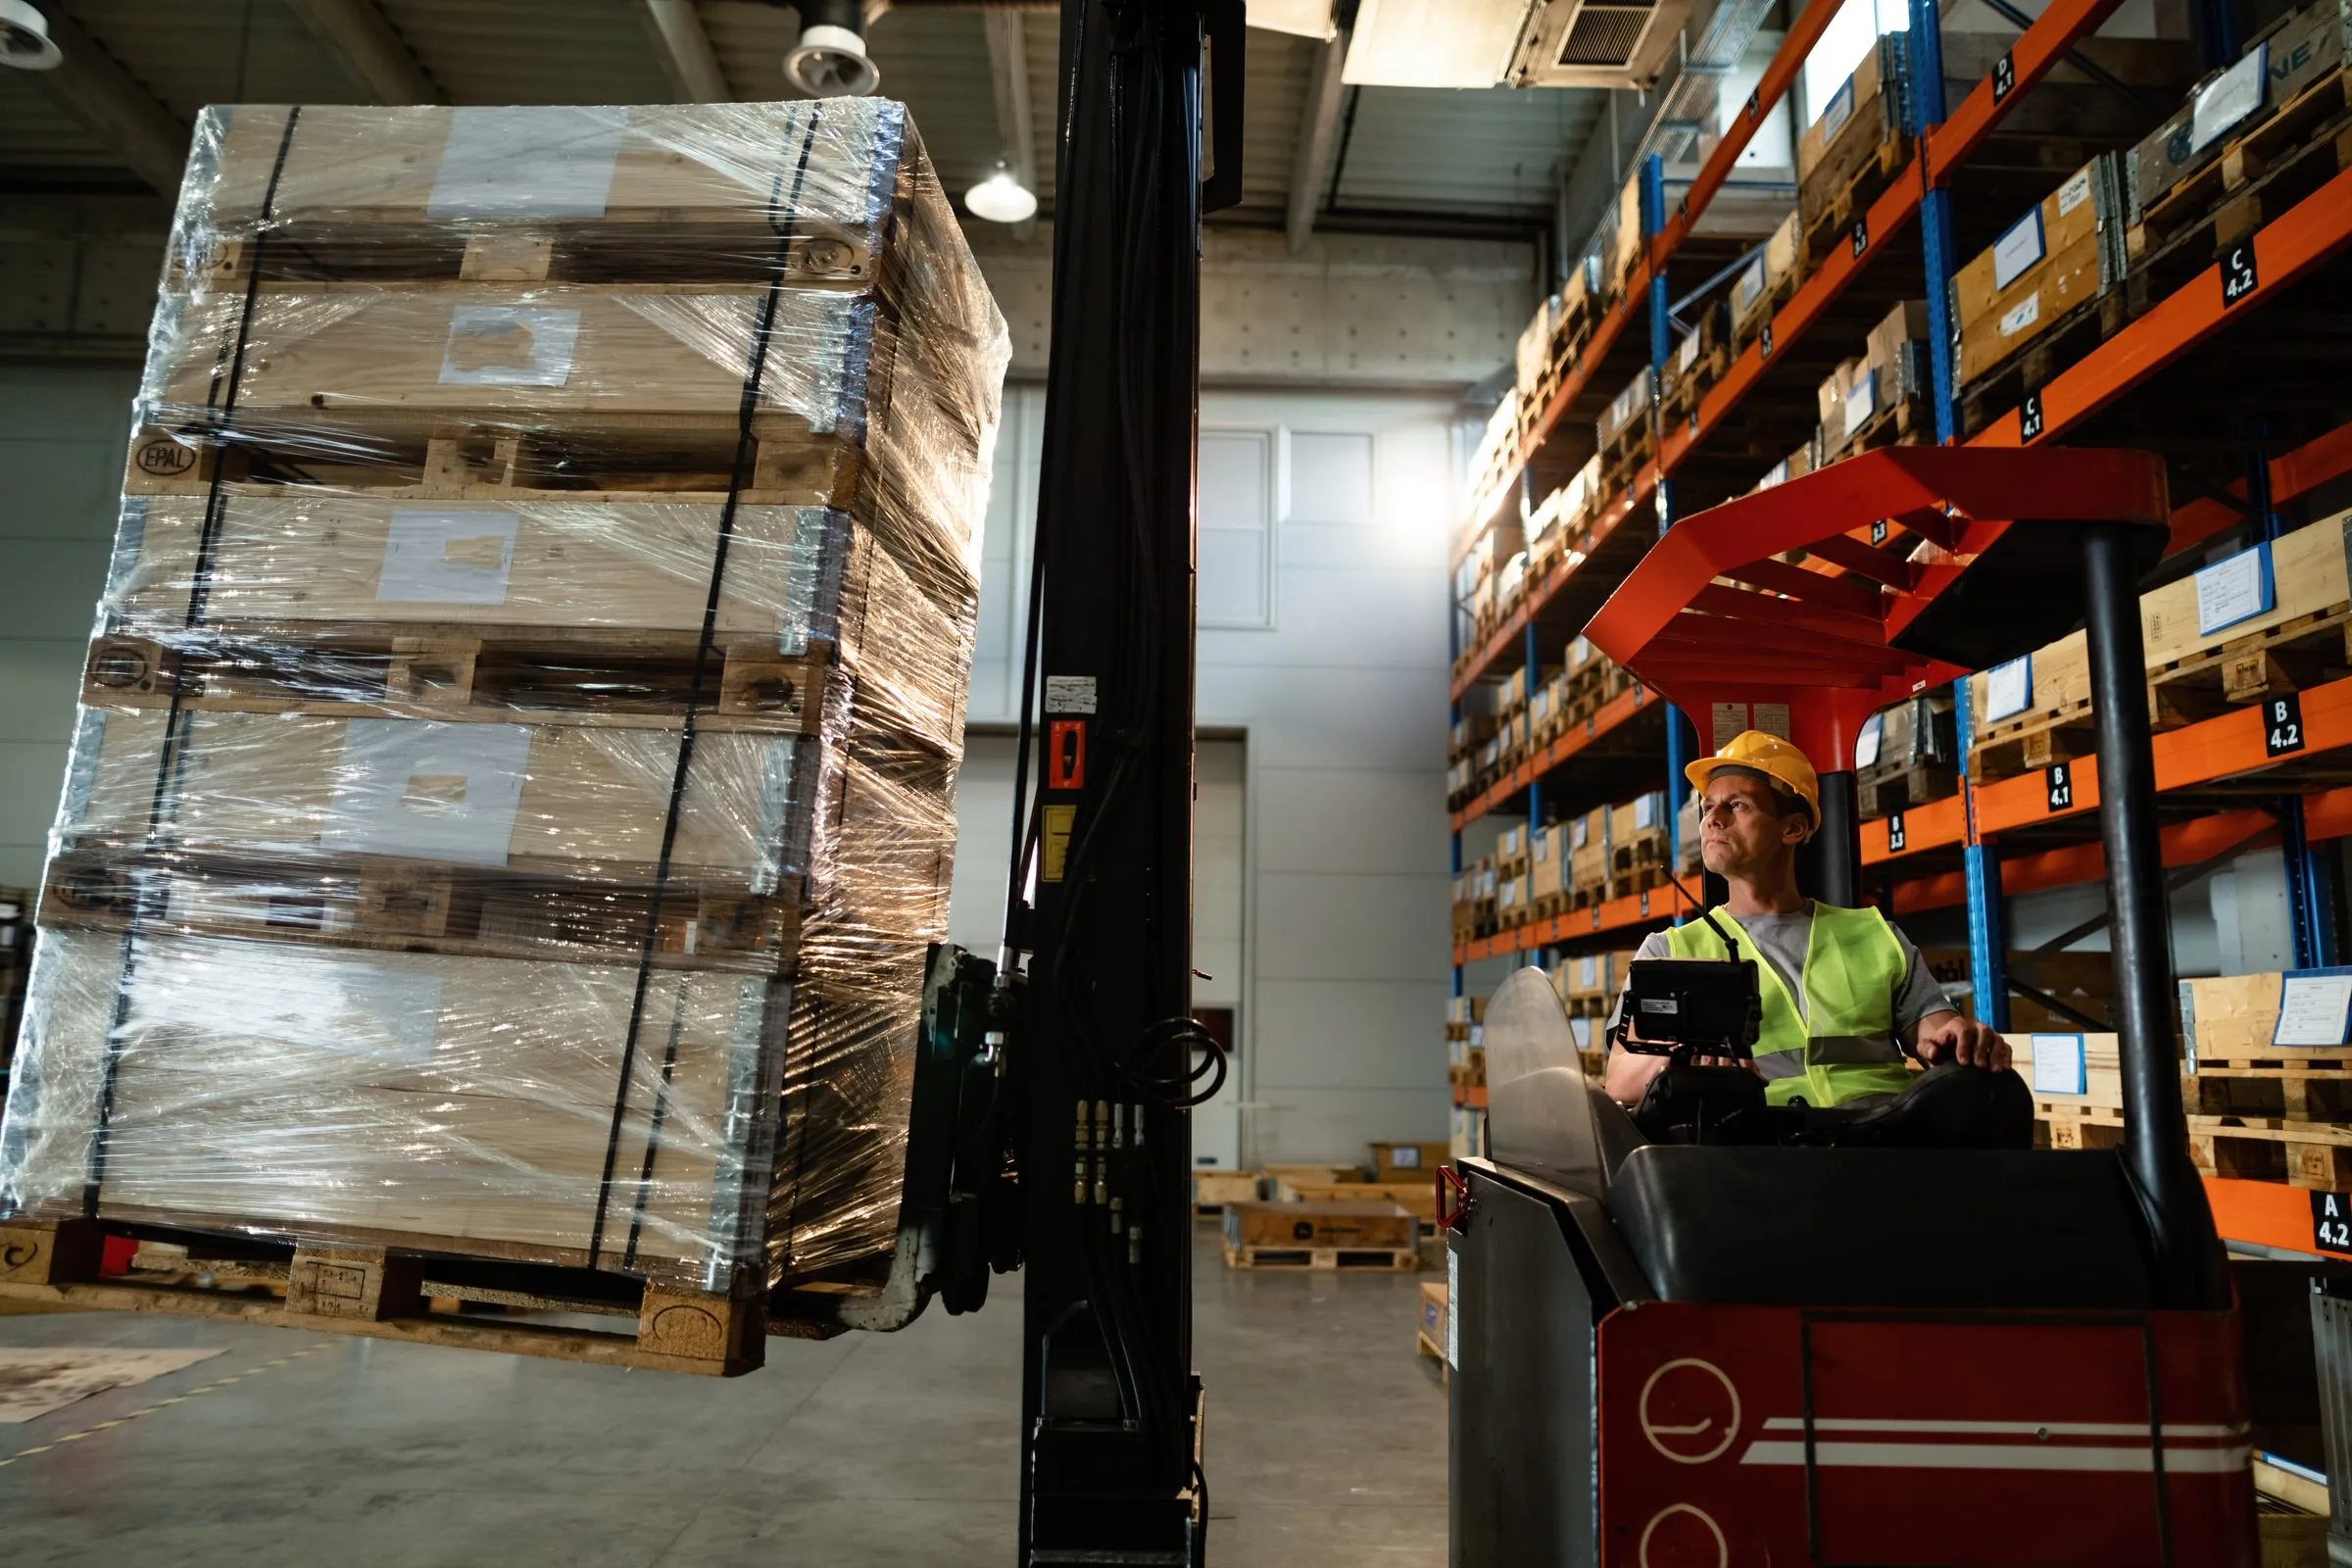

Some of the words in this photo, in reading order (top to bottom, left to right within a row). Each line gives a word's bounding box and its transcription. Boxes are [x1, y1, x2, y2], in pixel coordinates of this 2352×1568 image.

[1998, 59, 2007, 76] D
[1995, 71, 2012, 95] 4.1
[2231, 248, 2243, 270] C
[2227, 269, 2253, 296] 4.2
[2027, 397, 2034, 415] C
[2024, 414, 2040, 435] 4.1
[145, 447, 185, 467] EPAL
[2275, 701, 2287, 722] B
[2271, 724, 2299, 748] 4.2
[2054, 766, 2063, 784] B
[2051, 786, 2069, 805] 4.1
[2325, 1194, 2339, 1217] A
[2319, 1221, 2350, 1246] 4.2
